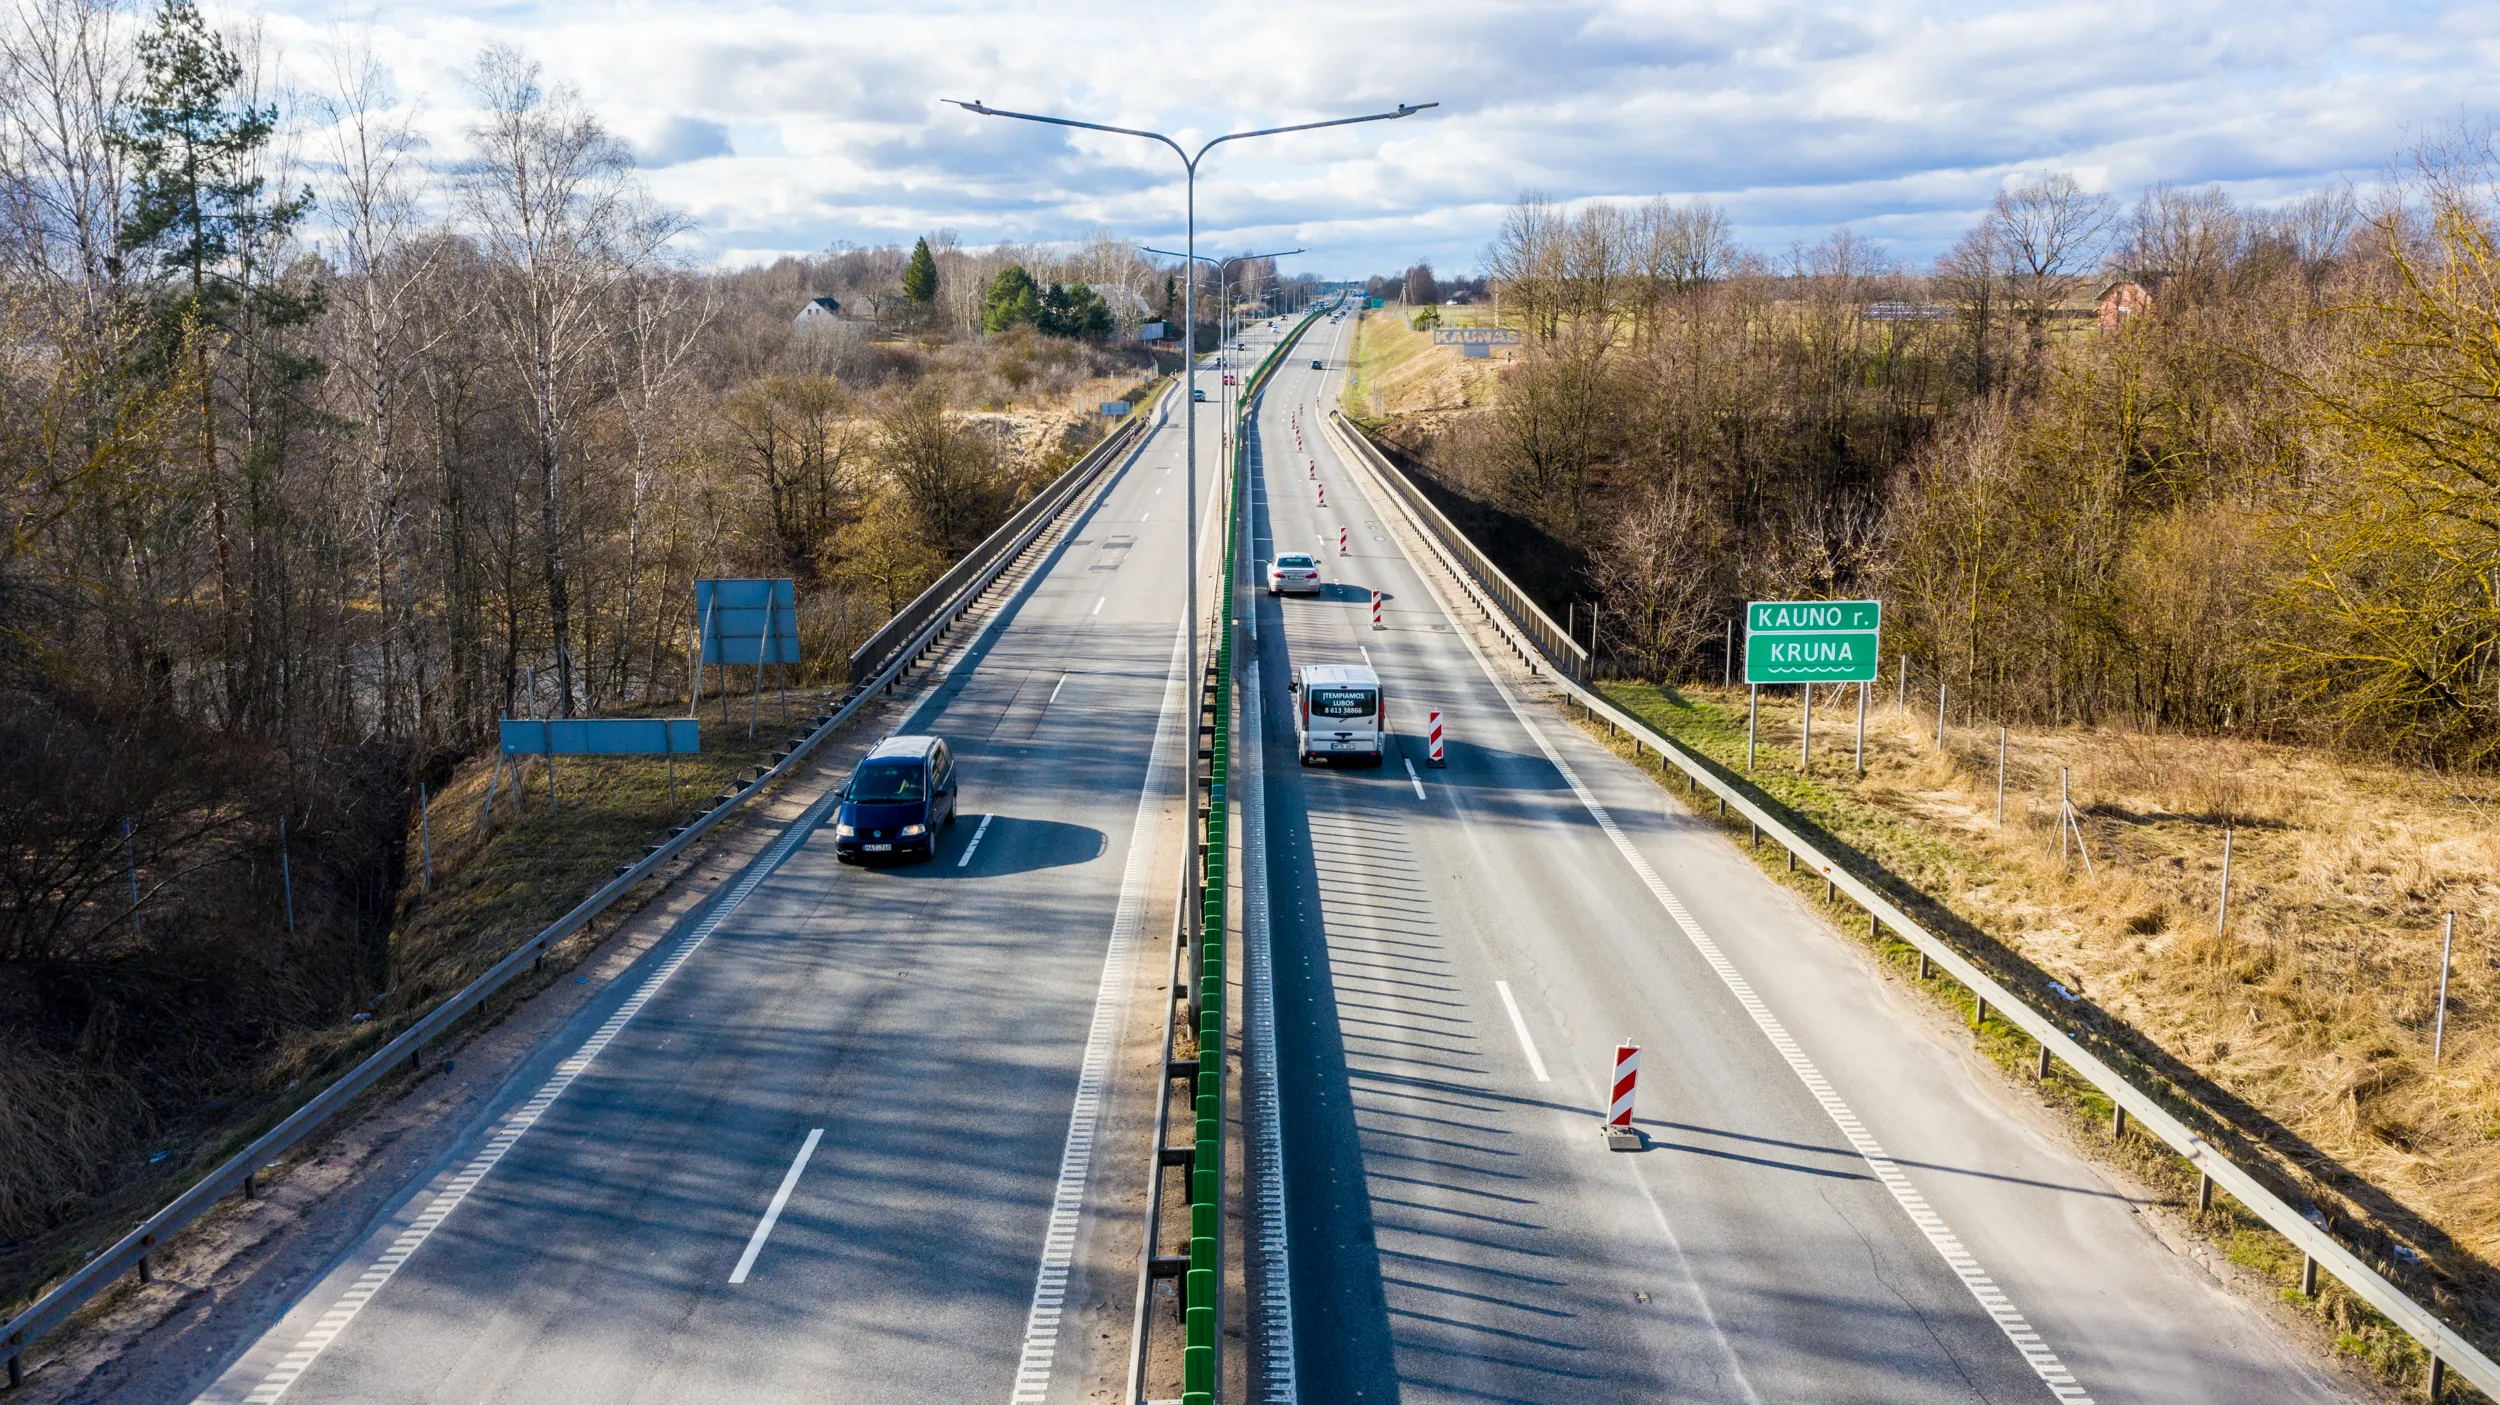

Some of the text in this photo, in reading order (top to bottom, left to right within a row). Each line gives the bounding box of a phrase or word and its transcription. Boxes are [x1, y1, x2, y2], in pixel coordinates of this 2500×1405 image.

[1434, 331, 1519, 343] KAUNAS
[1758, 607, 1869, 627] KAUNO r.
[1770, 642, 1853, 662] KRUNA
